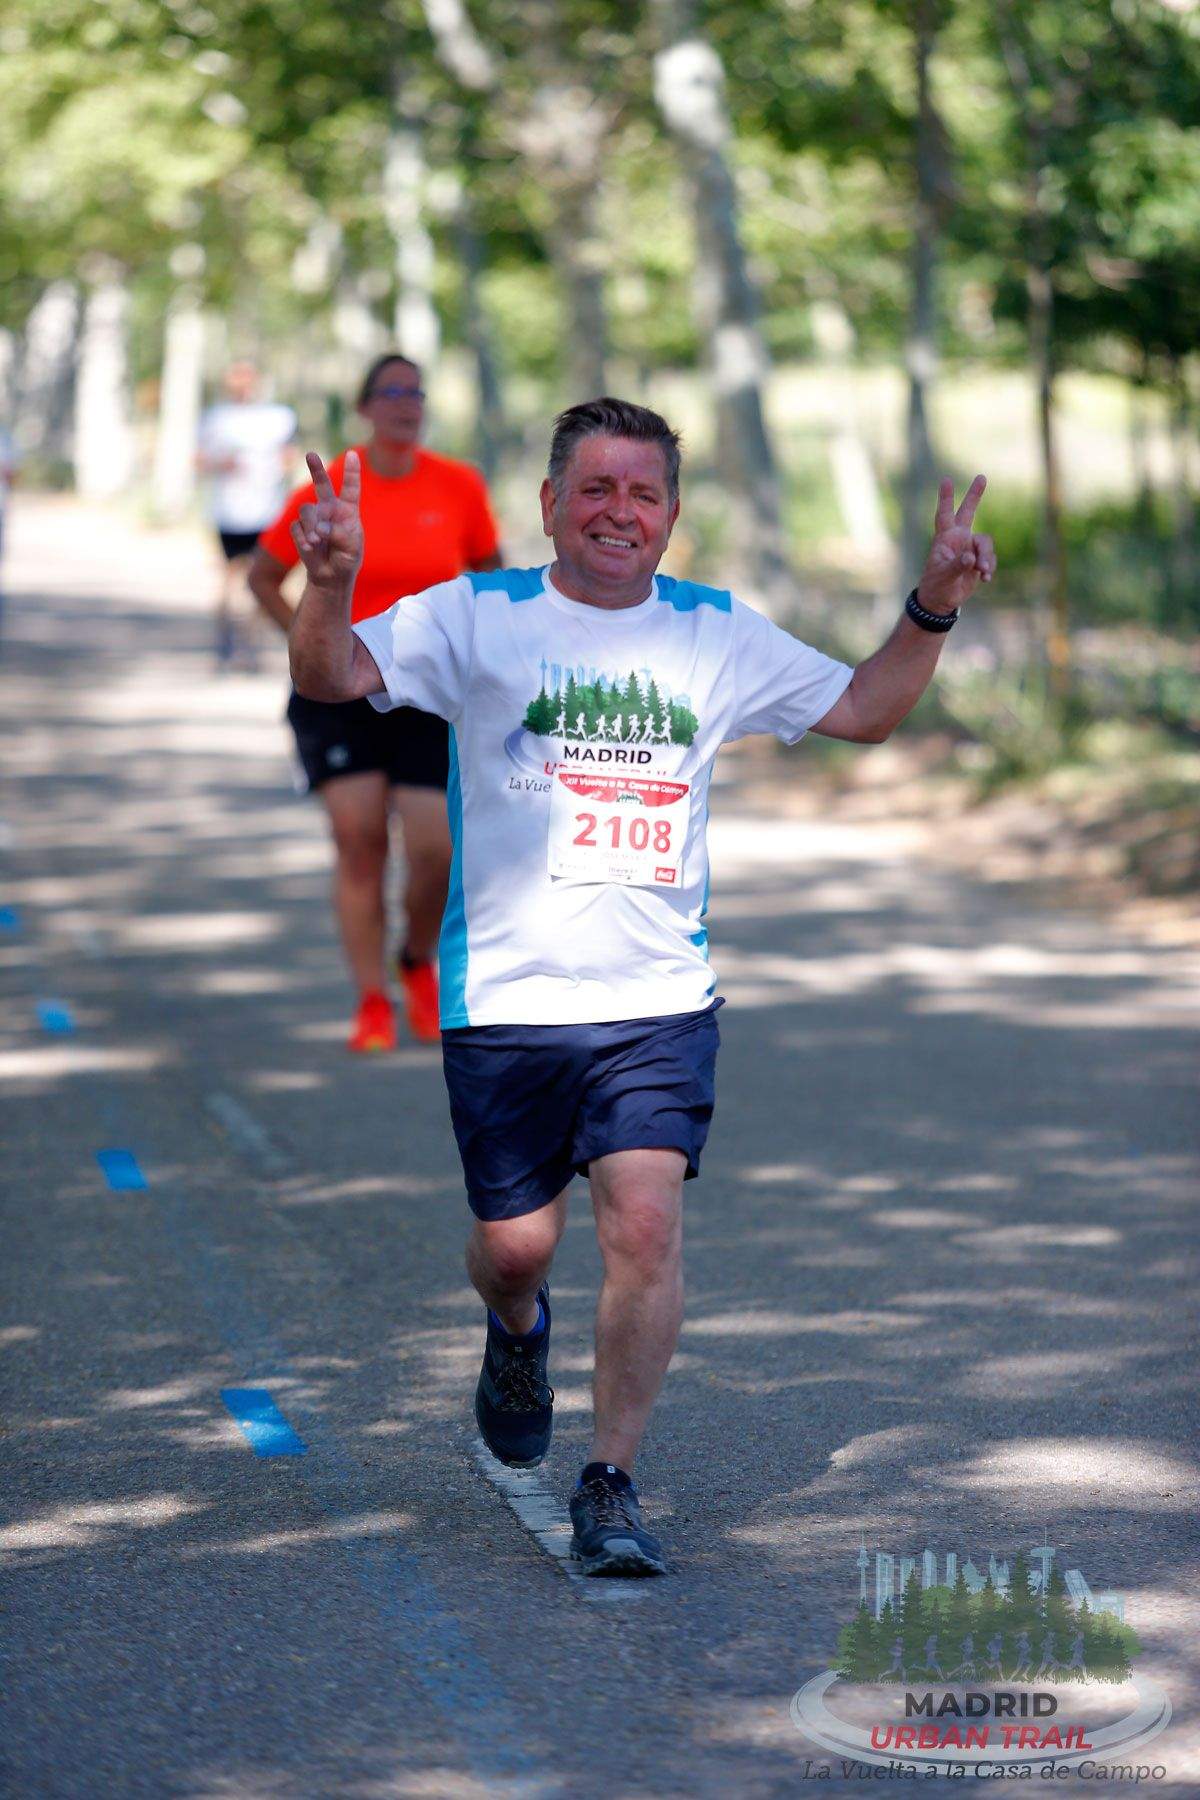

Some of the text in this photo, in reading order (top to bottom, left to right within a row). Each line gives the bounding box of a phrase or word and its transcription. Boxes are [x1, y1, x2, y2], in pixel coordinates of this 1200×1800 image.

[563, 745, 653, 765] MADRID
[508, 776, 551, 793] La Vue
[573, 812, 672, 854] 2108
